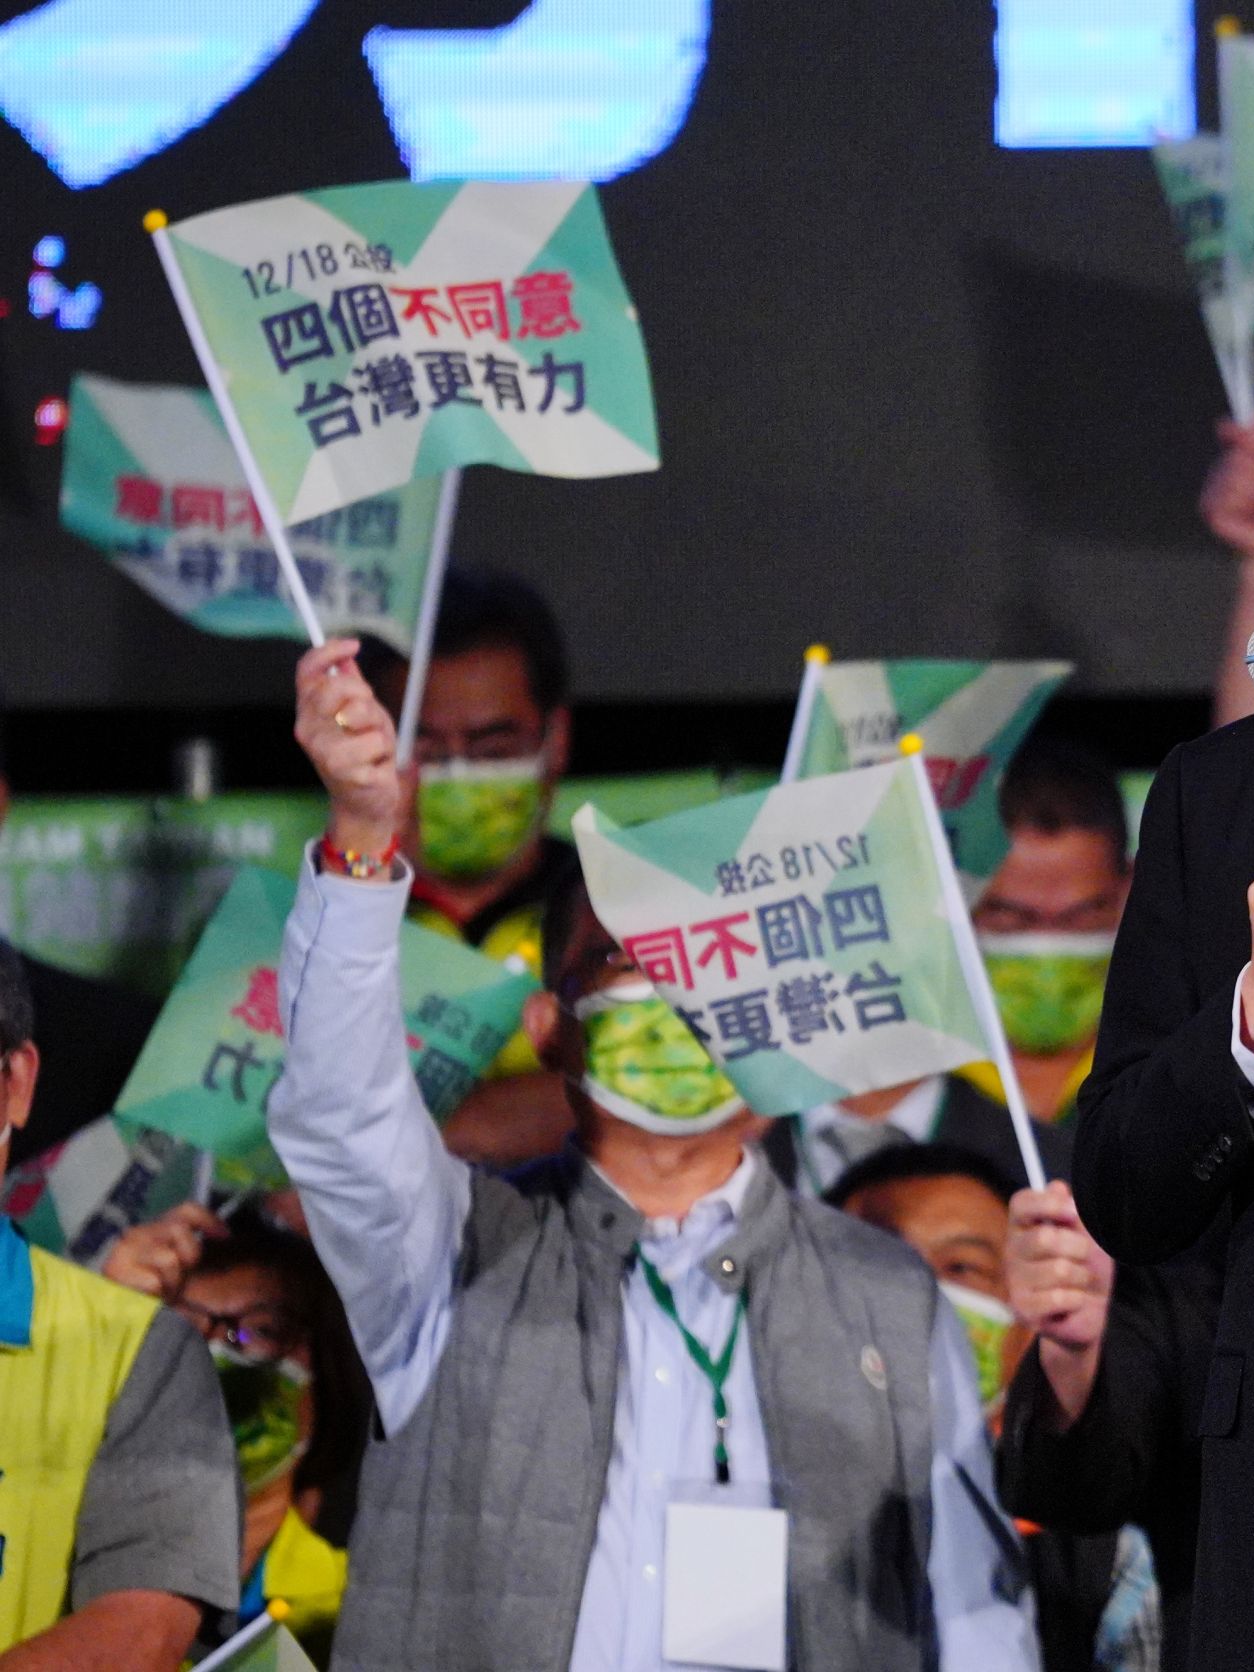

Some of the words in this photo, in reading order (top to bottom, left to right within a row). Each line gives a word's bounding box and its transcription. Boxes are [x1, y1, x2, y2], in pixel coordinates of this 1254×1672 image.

[241, 243, 340, 299] 12/18
[343, 242, 397, 274] 公投
[260, 270, 582, 376] 四個不同意
[293, 350, 587, 449] 台灣更有力
